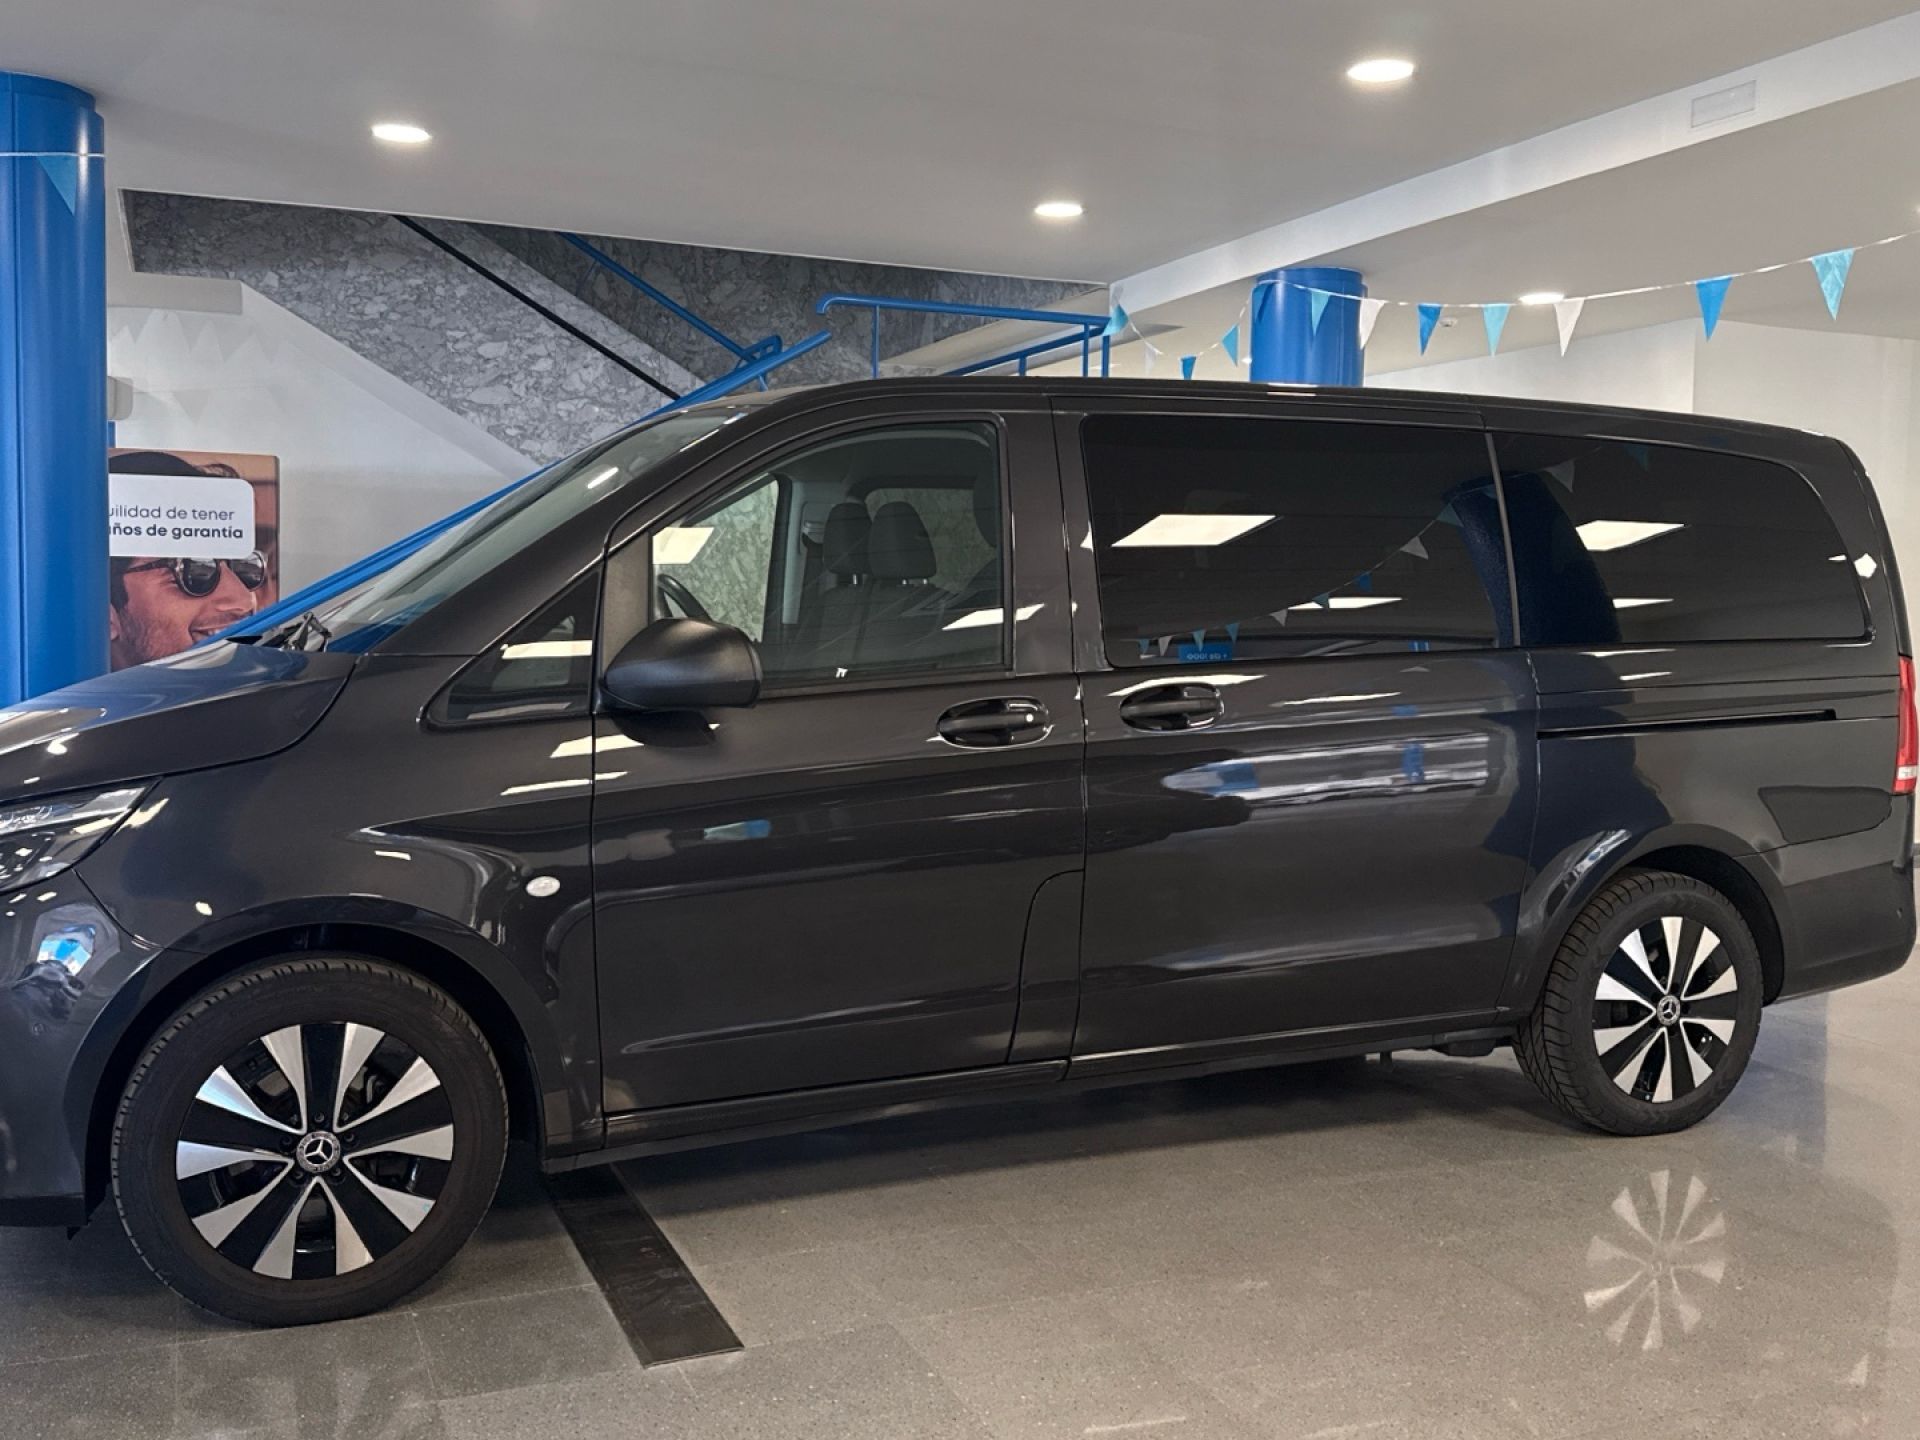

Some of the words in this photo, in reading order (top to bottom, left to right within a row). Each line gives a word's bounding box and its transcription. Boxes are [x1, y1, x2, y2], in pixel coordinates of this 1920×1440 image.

[167, 506, 188, 519] de
[192, 509, 235, 520] tener
[109, 522, 142, 536] ños
[146, 523, 168, 536] de
